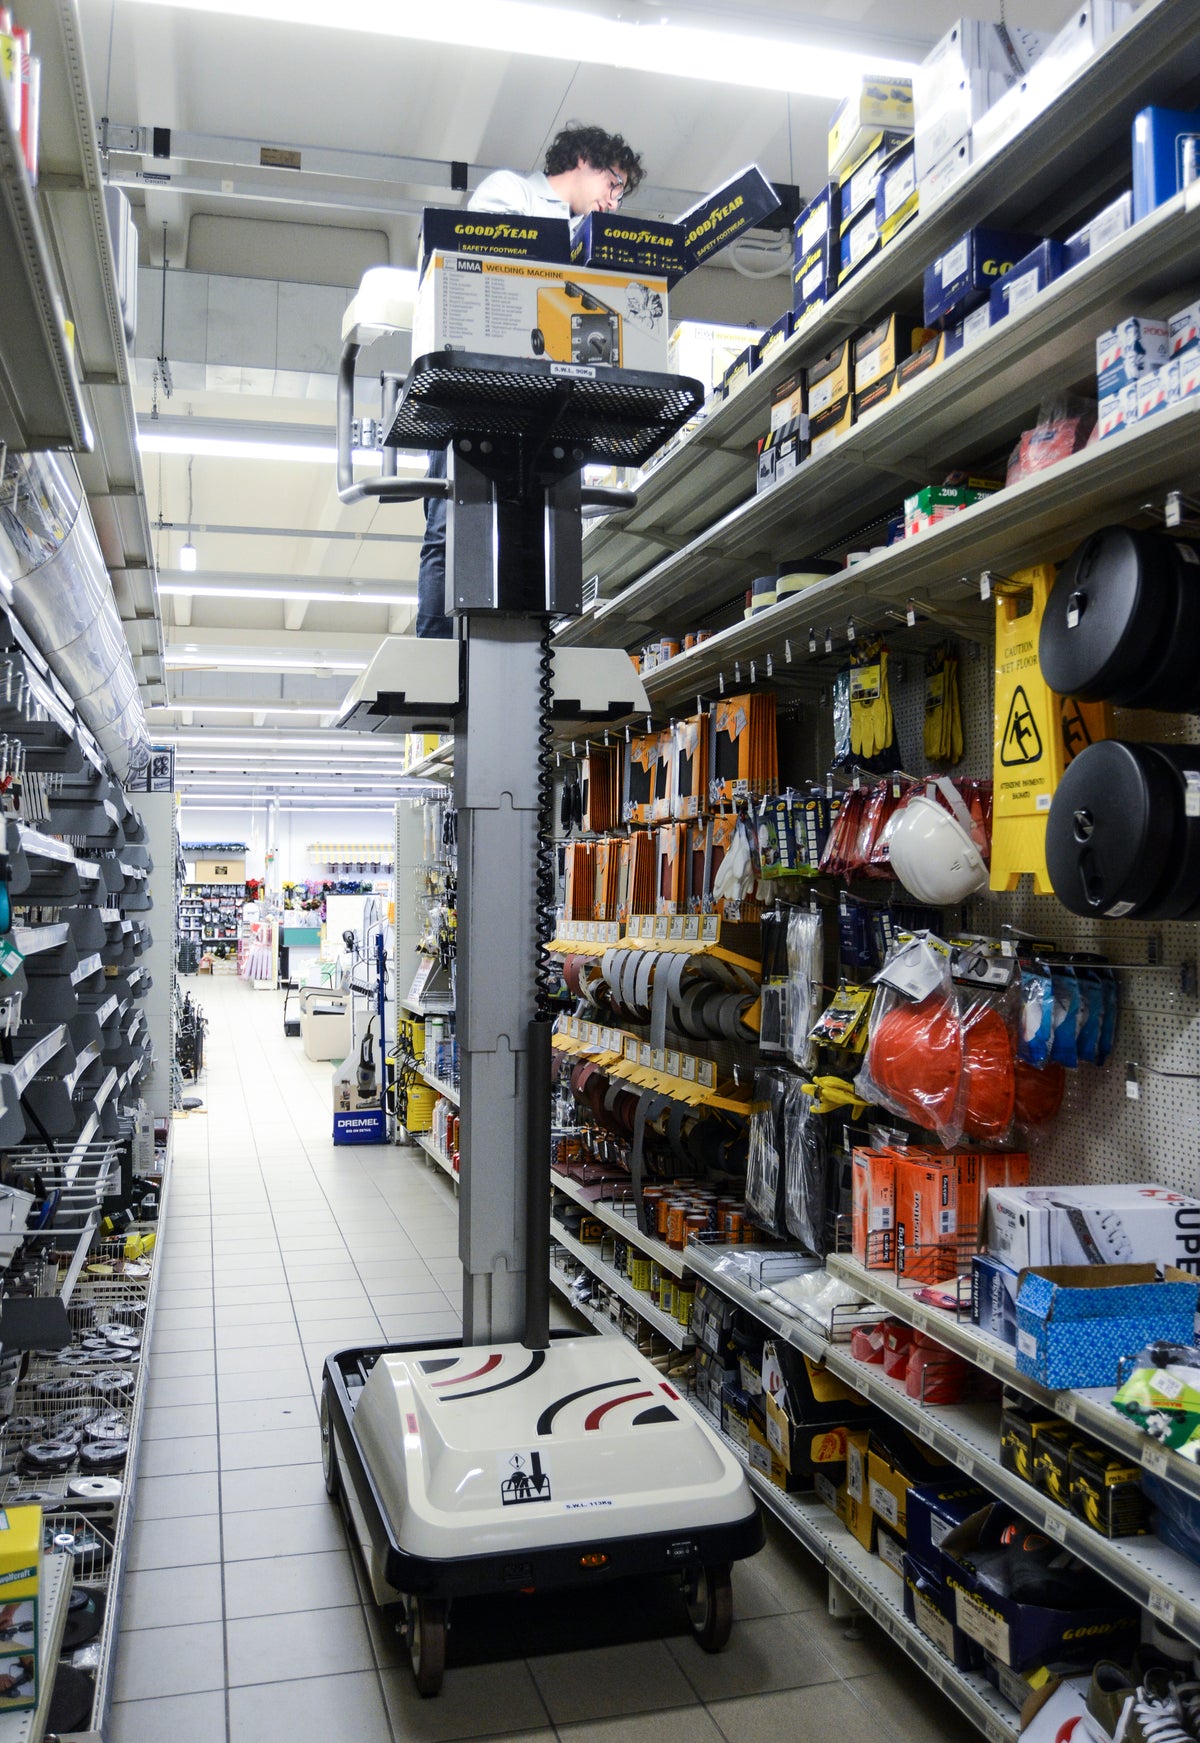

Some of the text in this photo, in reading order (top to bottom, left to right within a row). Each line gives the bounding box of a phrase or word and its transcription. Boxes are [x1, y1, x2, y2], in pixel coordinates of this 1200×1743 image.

[454, 223, 539, 240] GOODYEAR
[603, 228, 674, 247] GOODYEAR
[697, 217, 746, 257] SAFETY FOOTWEAR
[461, 243, 528, 256] SAFETY FOOTWEAR
[457, 260, 482, 272] MMA
[485, 265, 564, 280] WELDING MACHINE
[1003, 639, 1034, 660] CAUTION
[1016, 654, 1038, 671] FLOOR
[337, 1118, 380, 1128] DREMEL
